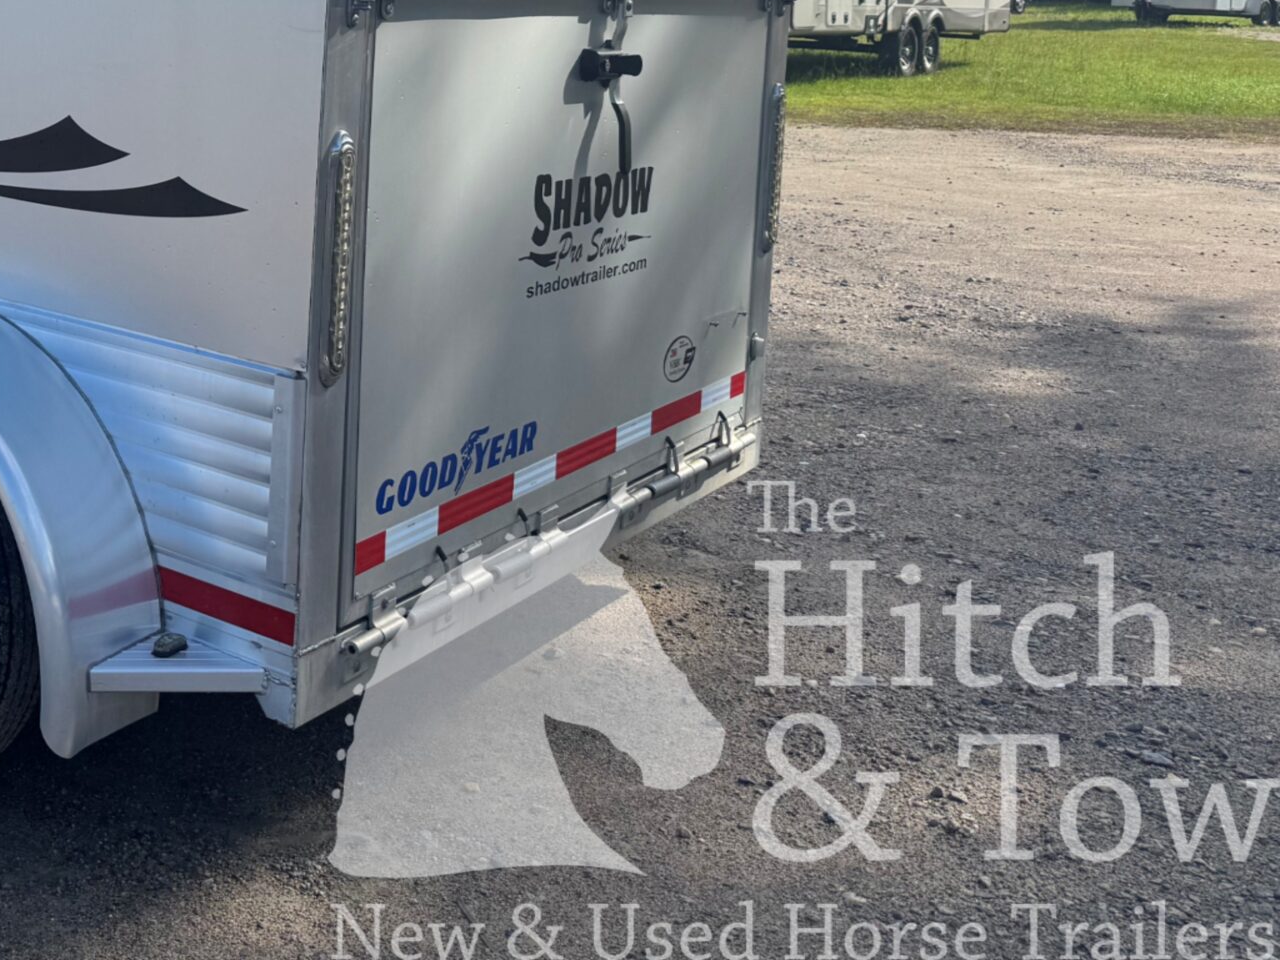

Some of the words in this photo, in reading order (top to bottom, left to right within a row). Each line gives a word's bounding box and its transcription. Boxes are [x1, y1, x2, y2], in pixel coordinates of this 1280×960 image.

[531, 166, 654, 247] SHADOW
[555, 230, 583, 271] Pro
[586, 227, 628, 262] Series
[525, 257, 648, 299] shadowtrailer.com
